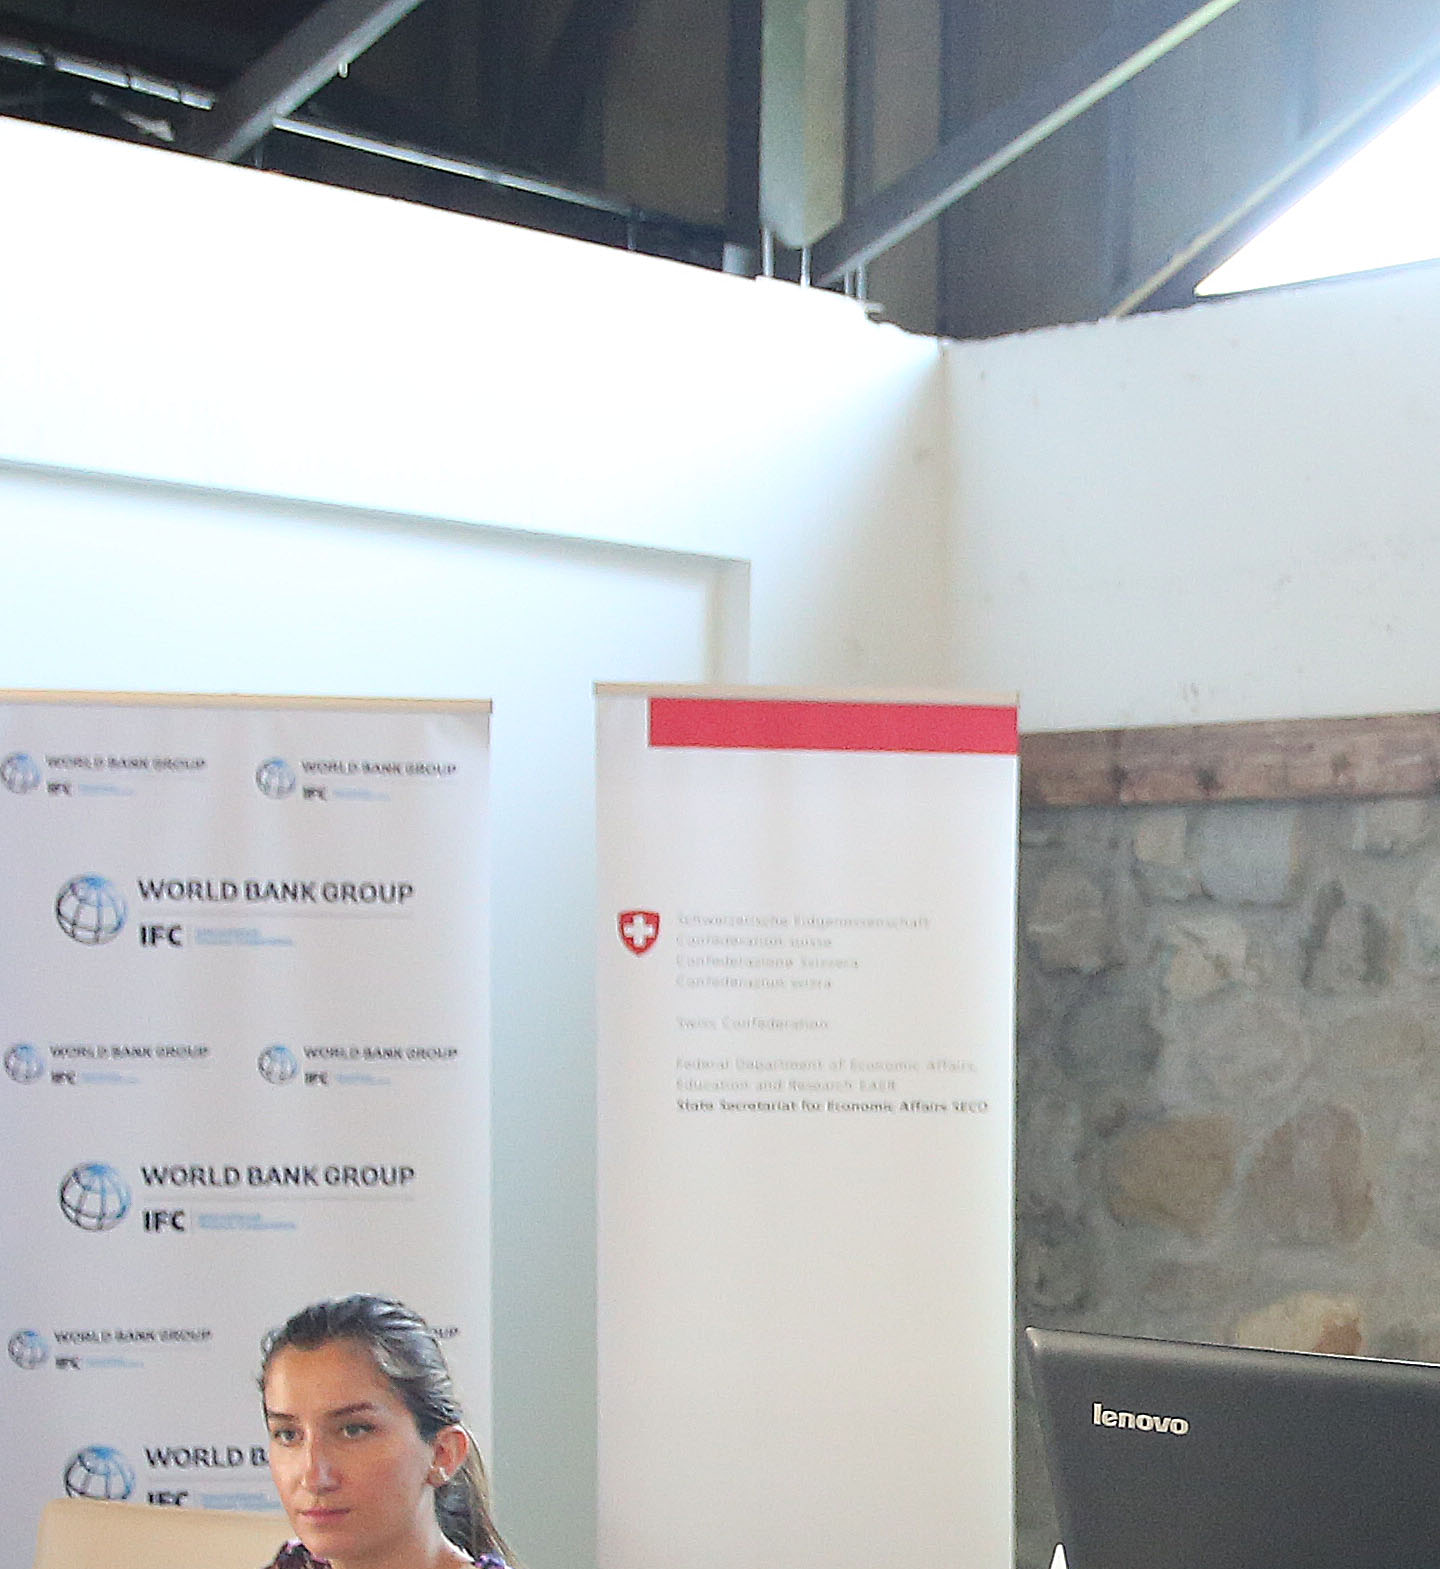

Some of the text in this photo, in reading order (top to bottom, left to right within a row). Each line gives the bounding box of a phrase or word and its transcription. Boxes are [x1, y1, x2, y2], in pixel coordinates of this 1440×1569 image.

[138, 878, 414, 905] WORLD BANK GROUP
[140, 924, 182, 946] IFC
[676, 1099, 714, 1112] State
[141, 1164, 416, 1188] WORLD BANK GROUP
[143, 1210, 185, 1232] IFC
[1092, 1402, 1190, 1436] lenovo
[145, 1446, 245, 1468] WORLD
